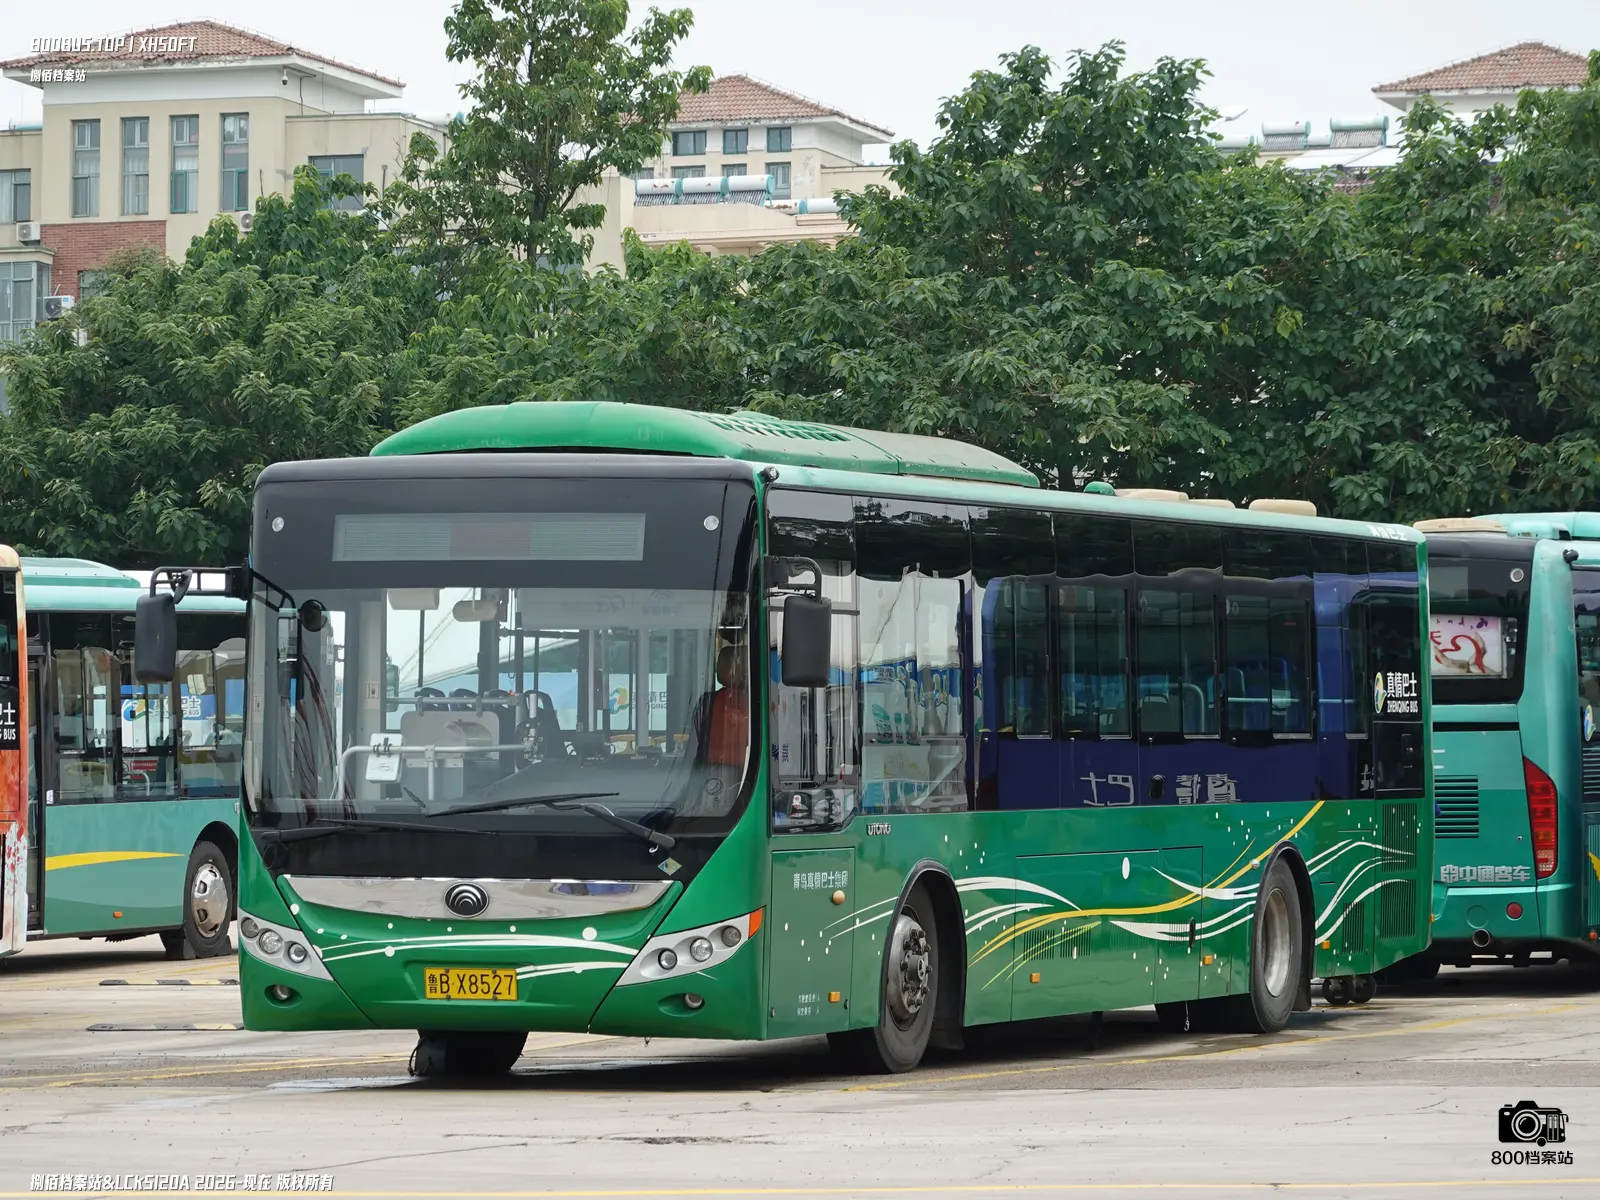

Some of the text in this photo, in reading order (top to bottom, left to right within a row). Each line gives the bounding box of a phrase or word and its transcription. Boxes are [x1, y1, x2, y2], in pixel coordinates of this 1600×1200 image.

[1386, 671, 1418, 698] 真情巴士
[0, 701, 16, 726] 士
[1386, 700, 1418, 713] ZHENQING BUS
[3, 728, 16, 741] BUS
[1459, 865, 1531, 883] 中通客车
